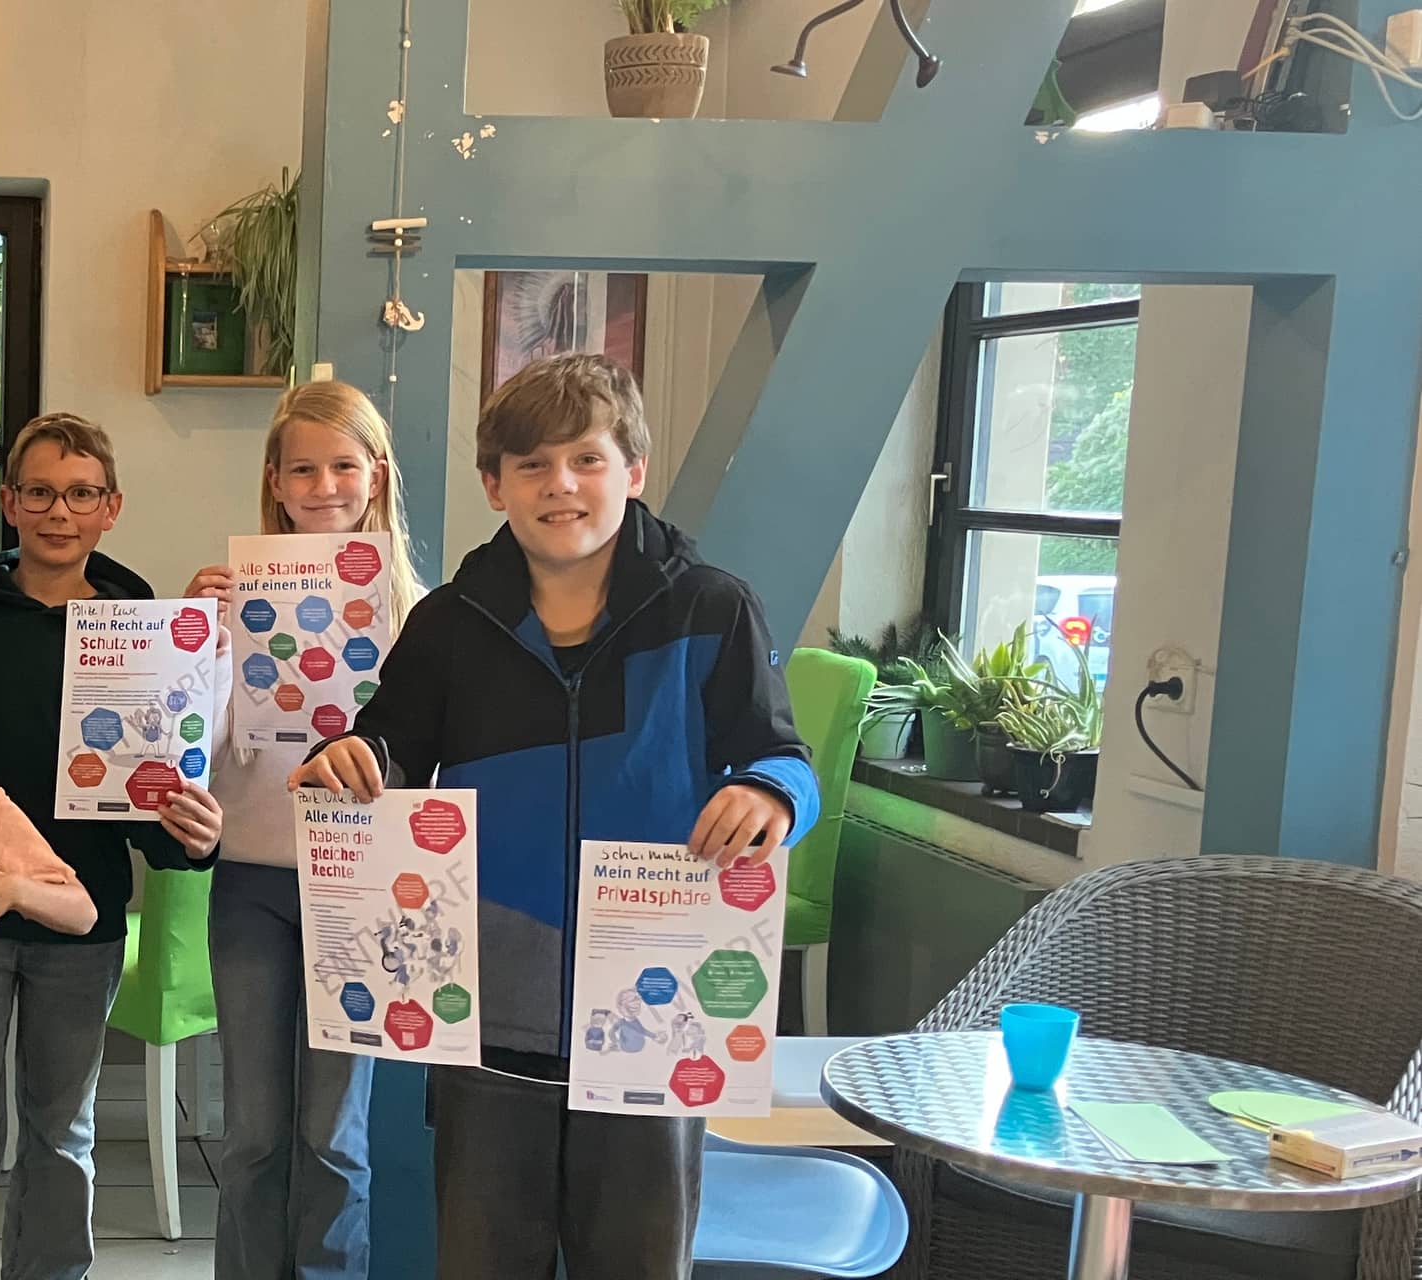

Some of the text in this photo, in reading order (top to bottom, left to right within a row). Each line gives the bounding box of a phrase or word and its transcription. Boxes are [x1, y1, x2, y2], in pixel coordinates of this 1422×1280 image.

[239, 561, 333, 576] Alle Stationen
[238, 577, 332, 592] auf einen Blick
[76, 618, 166, 631] Mein Recht auf
[80, 636, 153, 650] Schutz vor
[79, 653, 125, 667] Gewalt
[304, 809, 373, 825] Alle Kinder
[309, 828, 373, 845] haben die
[310, 845, 364, 862] gleichen
[311, 863, 355, 878] Rechte
[593, 865, 711, 883] Mein Recht auf
[597, 885, 711, 907] Privatsphäre
